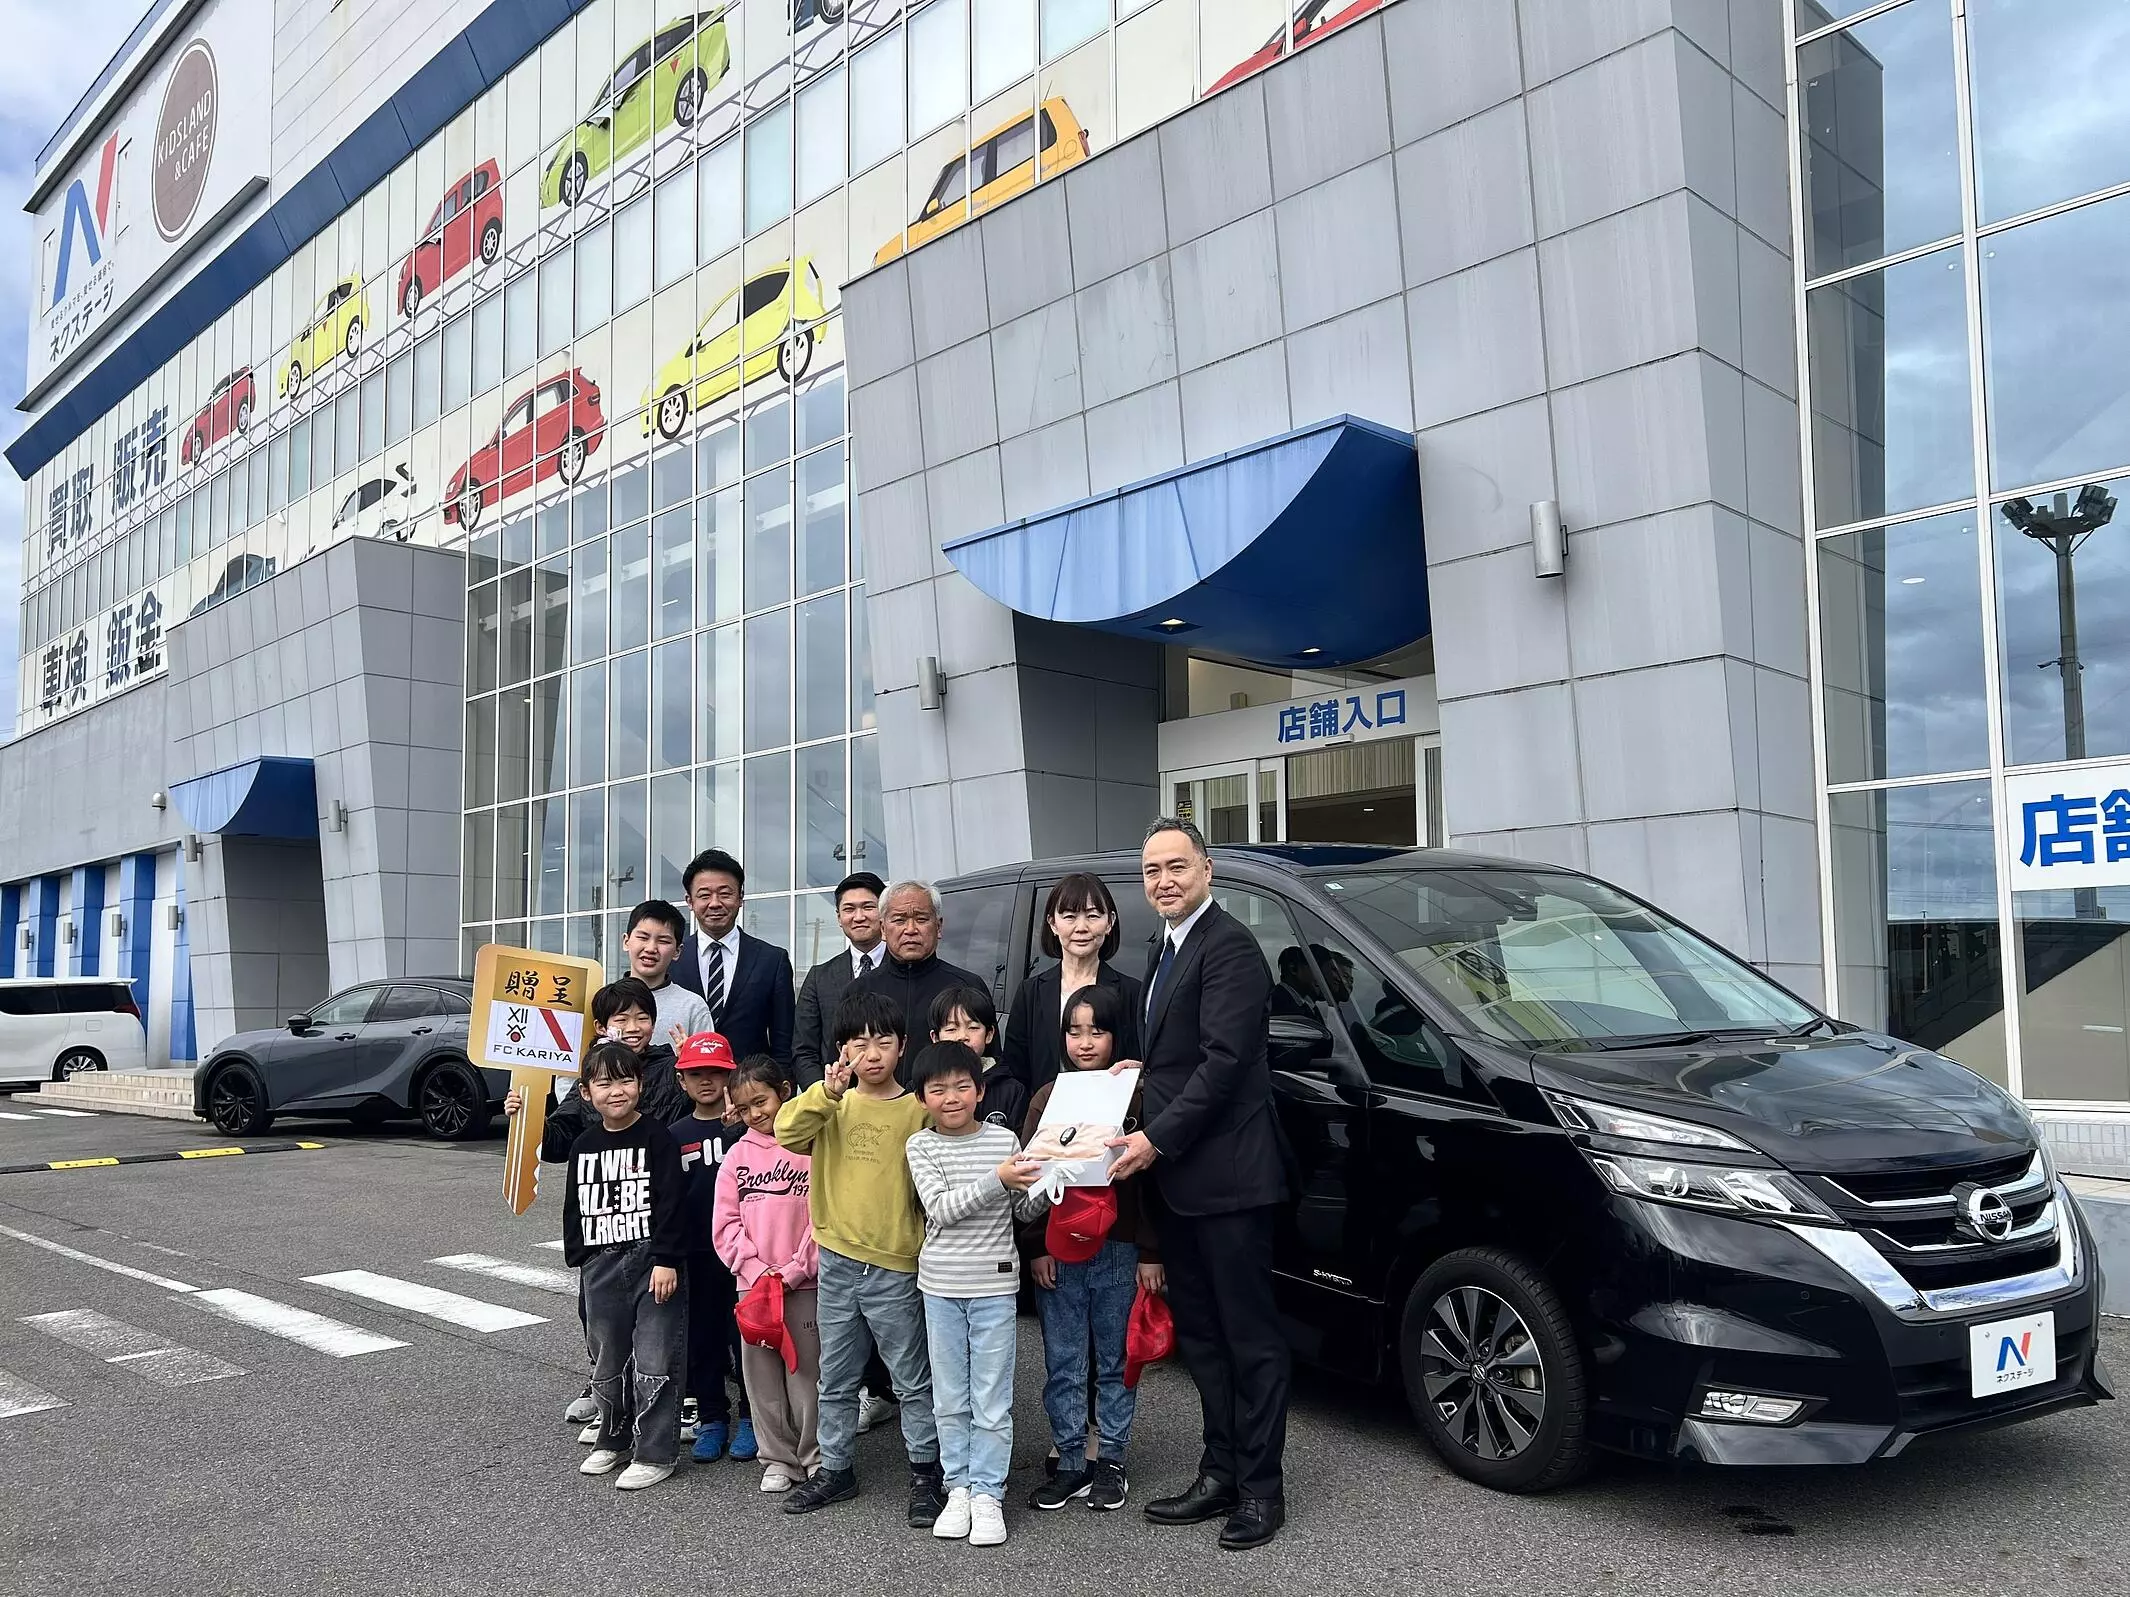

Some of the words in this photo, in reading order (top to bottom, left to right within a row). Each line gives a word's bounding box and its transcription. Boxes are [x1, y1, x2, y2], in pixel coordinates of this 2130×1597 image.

[158, 89, 212, 169] KIDSLAND
[174, 124, 209, 181] &CAFE
[50, 278, 115, 362] ネクステージ
[48, 463, 95, 560] 買取
[112, 404, 168, 516] 販売
[40, 629, 89, 717] 車検
[1278, 689, 1406, 743] 店舗入口
[504, 970, 573, 1006] 贈呈
[493, 1044, 513, 1055] FC
[516, 1047, 572, 1063] KARIYA
[577, 1152, 599, 1185] IT
[600, 1147, 651, 1182] WILL
[681, 1137, 726, 1172] FIL
[736, 1159, 809, 1189] Brooklyn
[792, 1184, 809, 1197] 197
[578, 1182, 613, 1216] ALL
[620, 1178, 652, 1213] BE
[1996, 1367, 2034, 1383] ネクステージ
